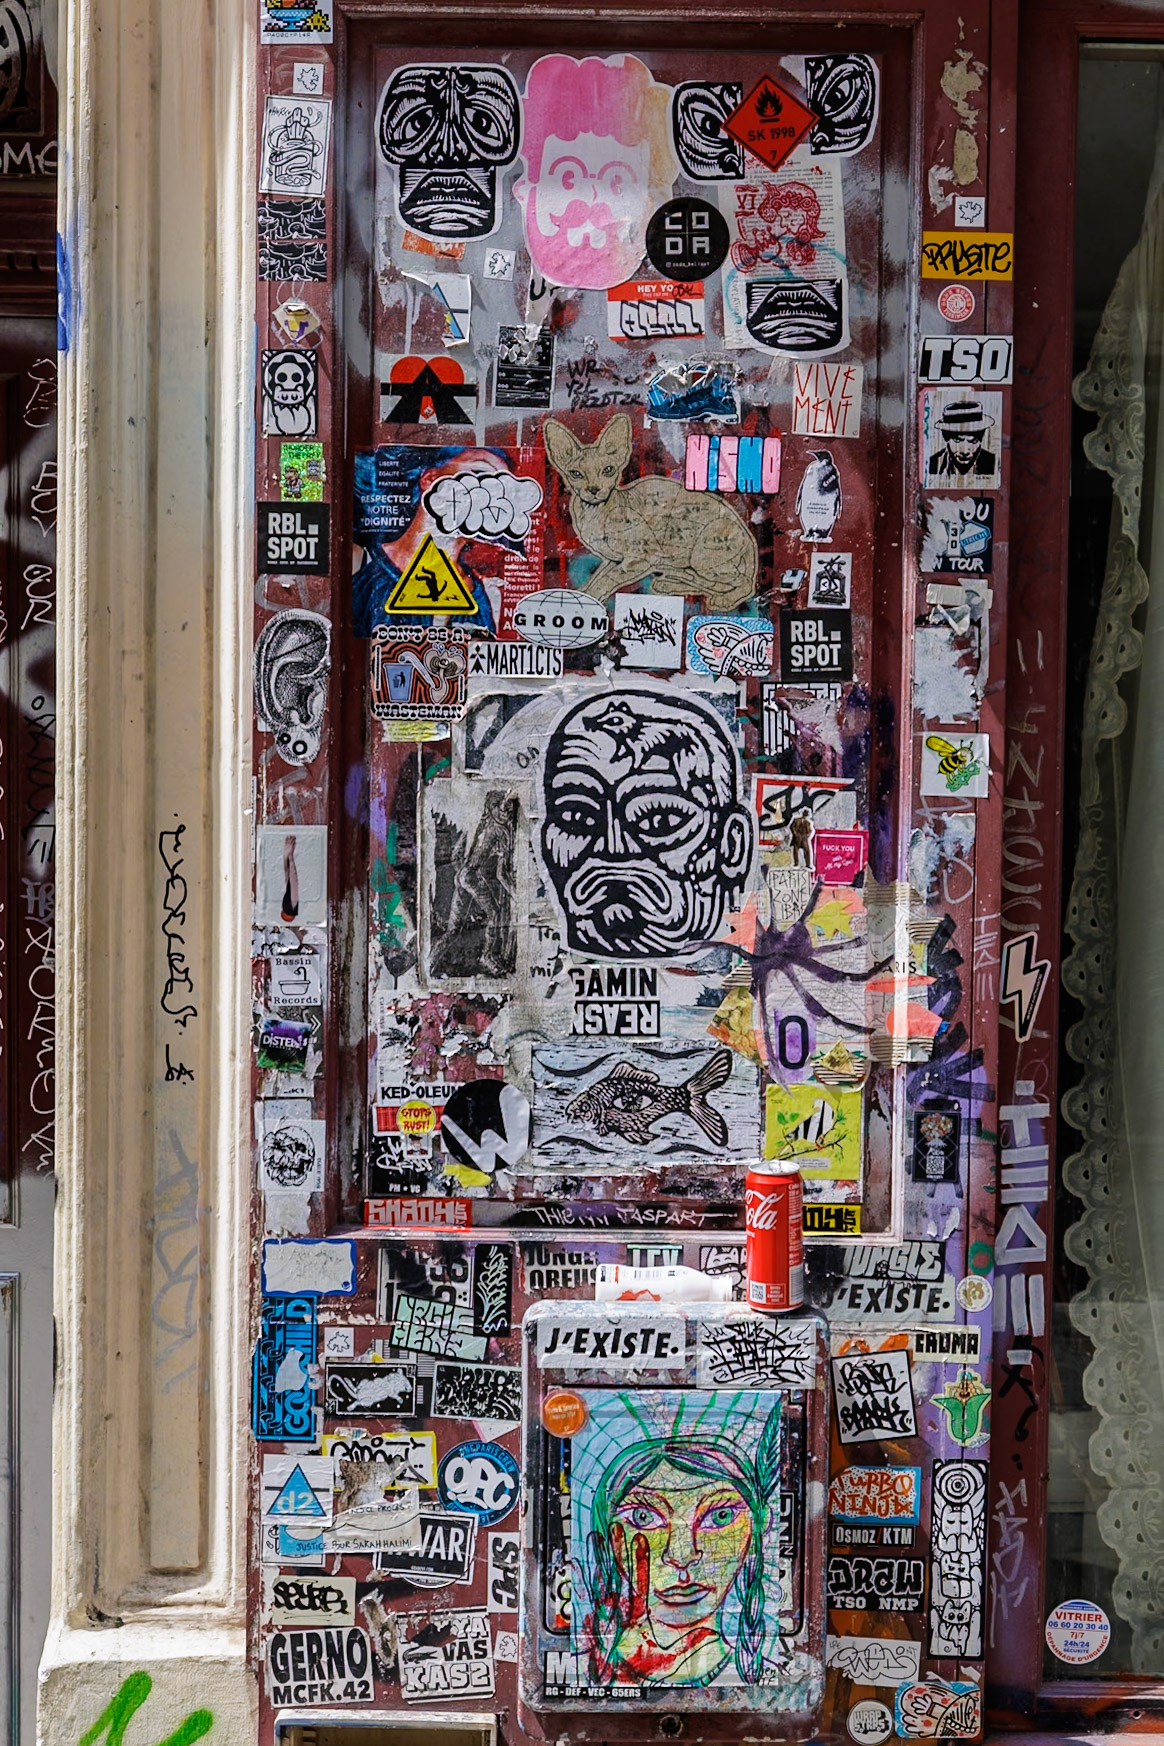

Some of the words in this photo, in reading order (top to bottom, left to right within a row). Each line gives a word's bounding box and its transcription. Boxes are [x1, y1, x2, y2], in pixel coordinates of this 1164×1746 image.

[747, 130, 766, 141] SK
[770, 127, 796, 139] 1998
[770, 151, 777, 161] 7
[637, 284, 659, 293] HEY
[923, 338, 1011, 382] TSO
[795, 363, 857, 400] VIVE
[794, 396, 852, 435] MENT
[360, 494, 411, 504] RESPECTEZ
[367, 505, 399, 515] NOTRE
[267, 536, 319, 560] SPOT
[949, 557, 985, 573] TOUR
[514, 613, 608, 631] GROOM
[427, 627, 448, 642] BE
[790, 643, 842, 666] SPOT
[841, 844, 855, 852] YOU
[275, 957, 312, 966] Bassin
[273, 996, 318, 1005] Records
[832, 1596, 867, 1610] TSO
[878, 1597, 920, 1611] NMP
[1055, 1611, 1103, 1623] VITRIER
[1060, 1621, 1071, 1629] 60
[270, 1628, 369, 1684] GERNO
[272, 1679, 371, 1705] MCFK.42
[545, 1686, 559, 1696] RG
[565, 1687, 581, 1696] DEF
[587, 1687, 606, 1697] VEC
[611, 1688, 642, 1698] 65ERS
